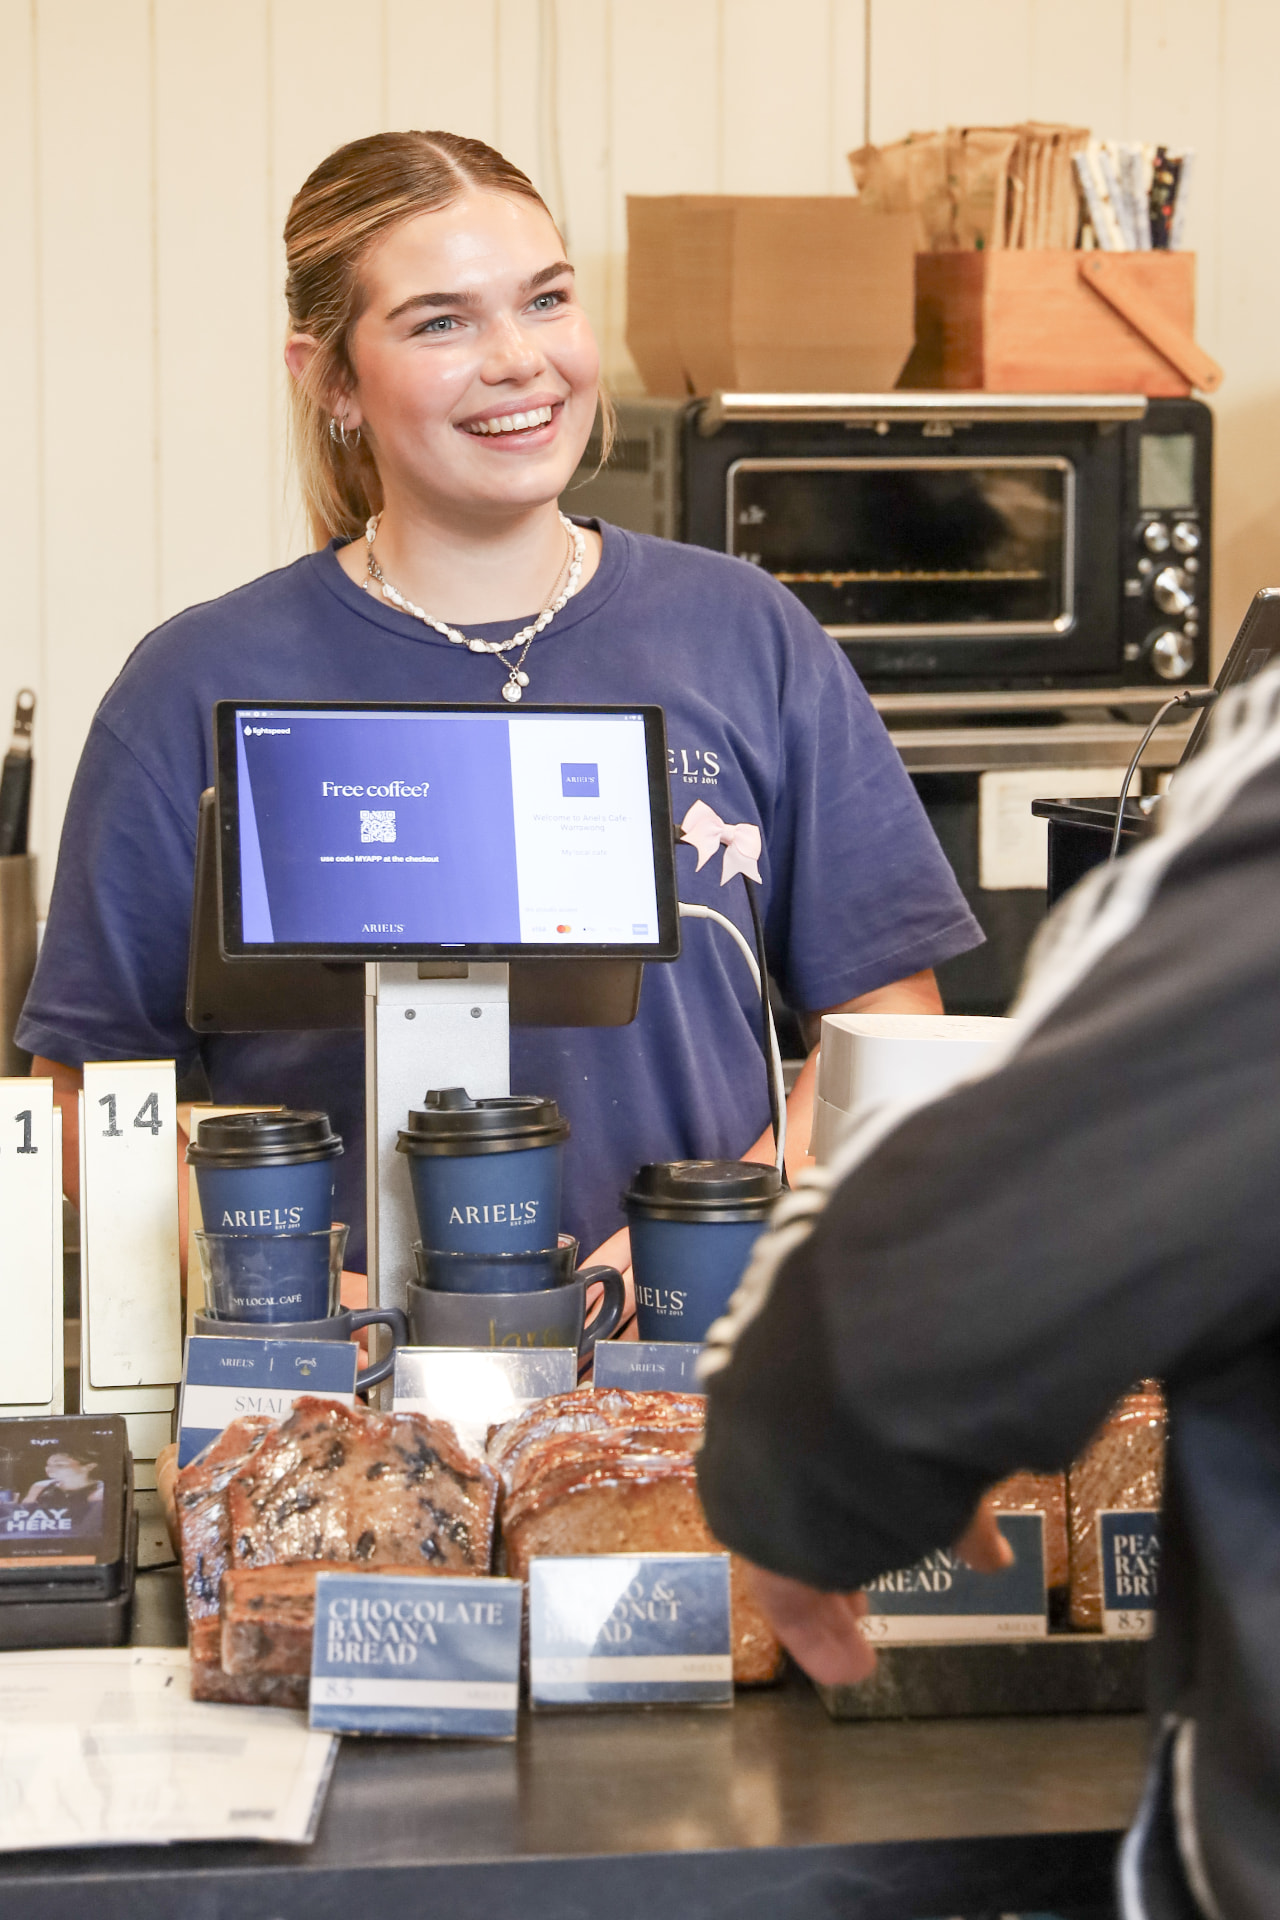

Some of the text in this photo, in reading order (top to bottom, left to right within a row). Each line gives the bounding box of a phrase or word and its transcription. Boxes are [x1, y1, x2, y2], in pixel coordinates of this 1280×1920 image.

[252, 727, 291, 736] lightspeed
[667, 749, 720, 777] EL'S
[322, 780, 430, 798] Free coffee?
[532, 814, 571, 822] Welcome
[572, 814, 581, 822] to
[335, 855, 355, 863] code
[355, 855, 383, 863] MYAPP
[392, 855, 404, 863] the
[405, 855, 440, 863] checkout
[361, 923, 405, 933] ARIEL'S
[98, 1092, 163, 1137] 14
[221, 1206, 301, 1227] ARIEL'S
[449, 1200, 537, 1224] ARIEL'S
[245, 1297, 278, 1306] LOCAL
[635, 1284, 684, 1310] IEL'S
[6, 1518, 72, 1532] HERE
[13, 1508, 69, 1521] PAY
[1114, 1533, 1160, 1555] PEA
[328, 1598, 503, 1625] CHOCOLATE
[327, 1618, 438, 1645] BANANA
[326, 1641, 418, 1665] BREAD
